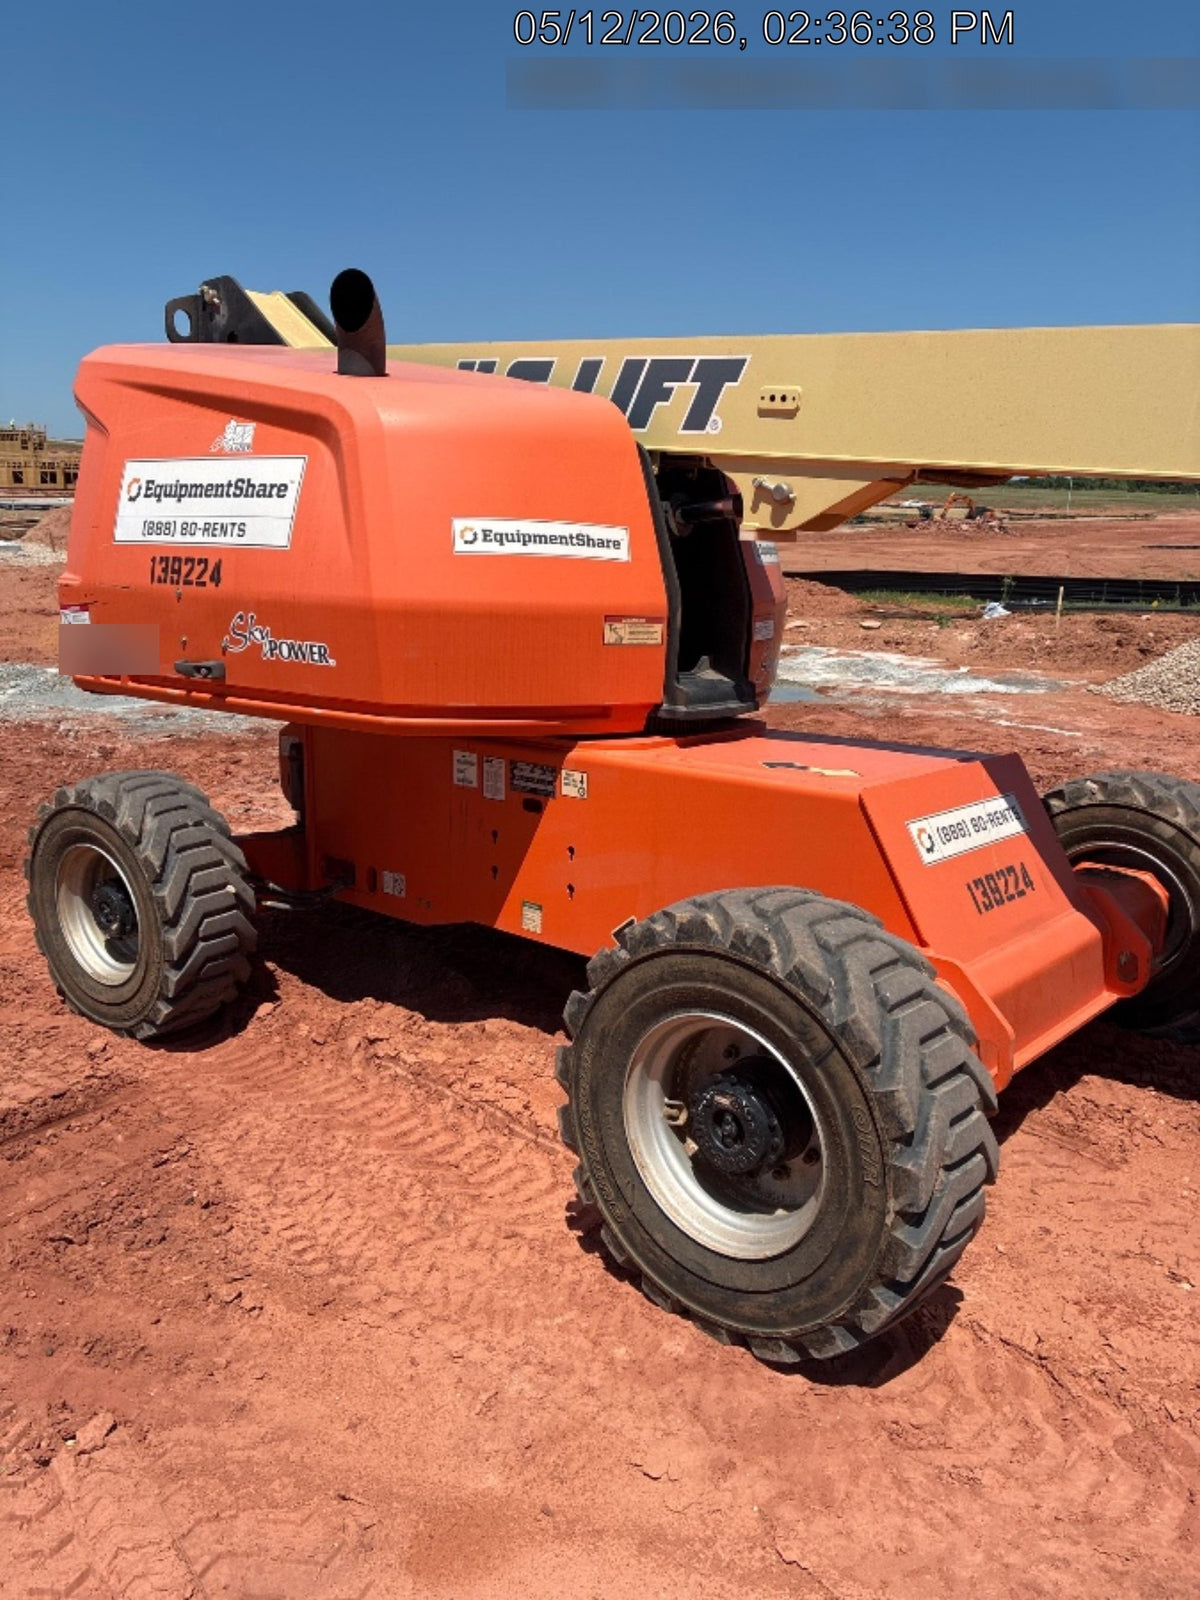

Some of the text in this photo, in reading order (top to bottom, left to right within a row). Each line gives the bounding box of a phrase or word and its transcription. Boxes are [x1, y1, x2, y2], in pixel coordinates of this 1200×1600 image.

[143, 478, 288, 503] EquipmentShare
[142, 520, 246, 538] (888) 80-RENTS
[481, 529, 622, 550] EquipmentShare
[149, 556, 222, 587] 139224
[221, 611, 270, 660] Sky
[266, 639, 330, 665] POWER
[936, 806, 1021, 845] (888) 80-RENTS
